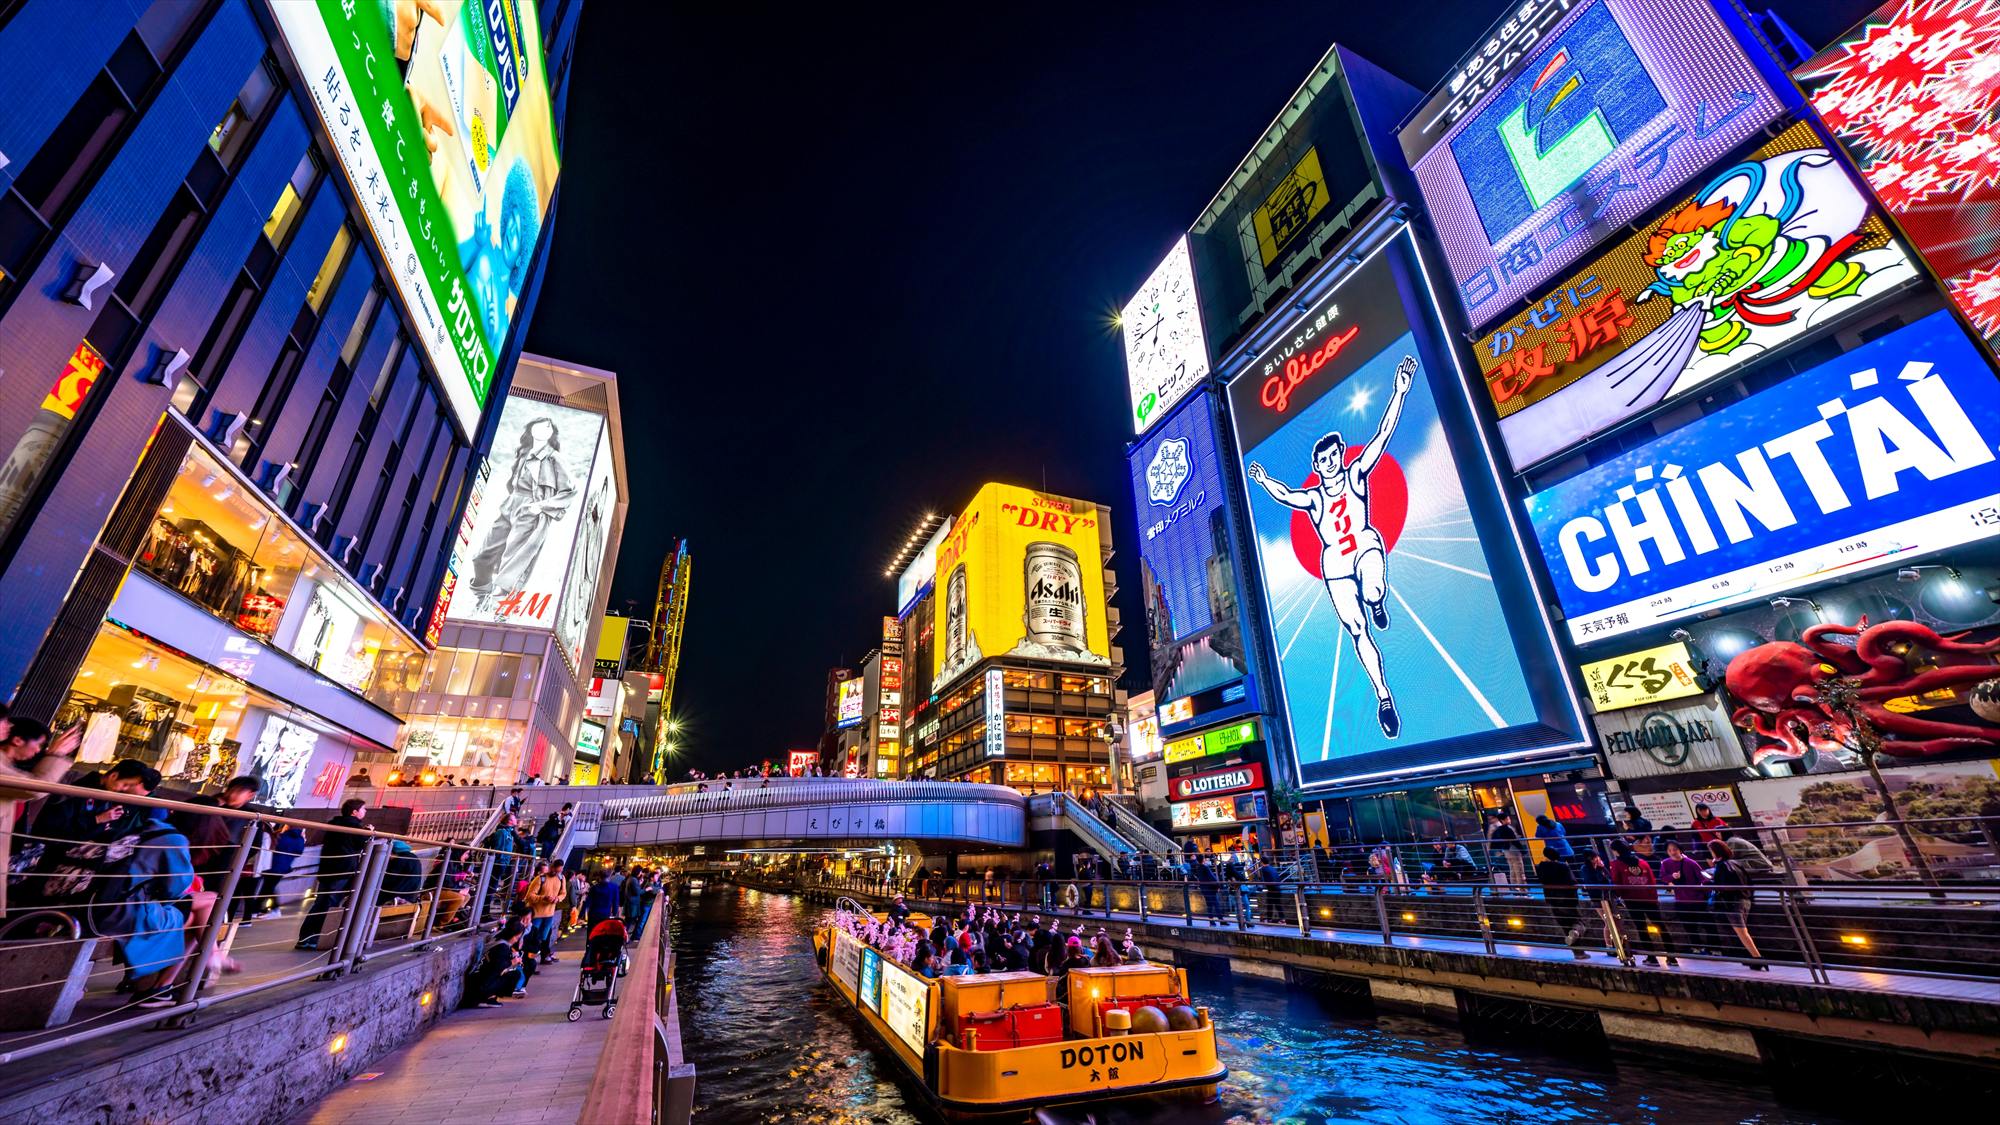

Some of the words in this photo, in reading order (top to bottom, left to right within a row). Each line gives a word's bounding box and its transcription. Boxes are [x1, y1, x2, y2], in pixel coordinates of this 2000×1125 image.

[1450, 0, 1544, 94] 夢ある住ま
[448, 276, 489, 394] サロンパス
[1488, 275, 1602, 358] かぜに
[1264, 304, 1340, 376] おいしさと健康
[1486, 287, 1635, 404] 改源
[1158, 359, 1187, 399] ピップ
[1329, 494, 1358, 557] グリコ
[494, 590, 552, 620] H&M
[1030, 577, 1079, 605] Asahi
[1049, 607, 1064, 619] 生
[1580, 612, 1630, 636] 天気予報
[1606, 657, 1673, 694] くくる
[1193, 771, 1247, 792] LOTTERIA
[810, 817, 886, 831] えびす橋
[1060, 1040, 1144, 1069] DOTON
